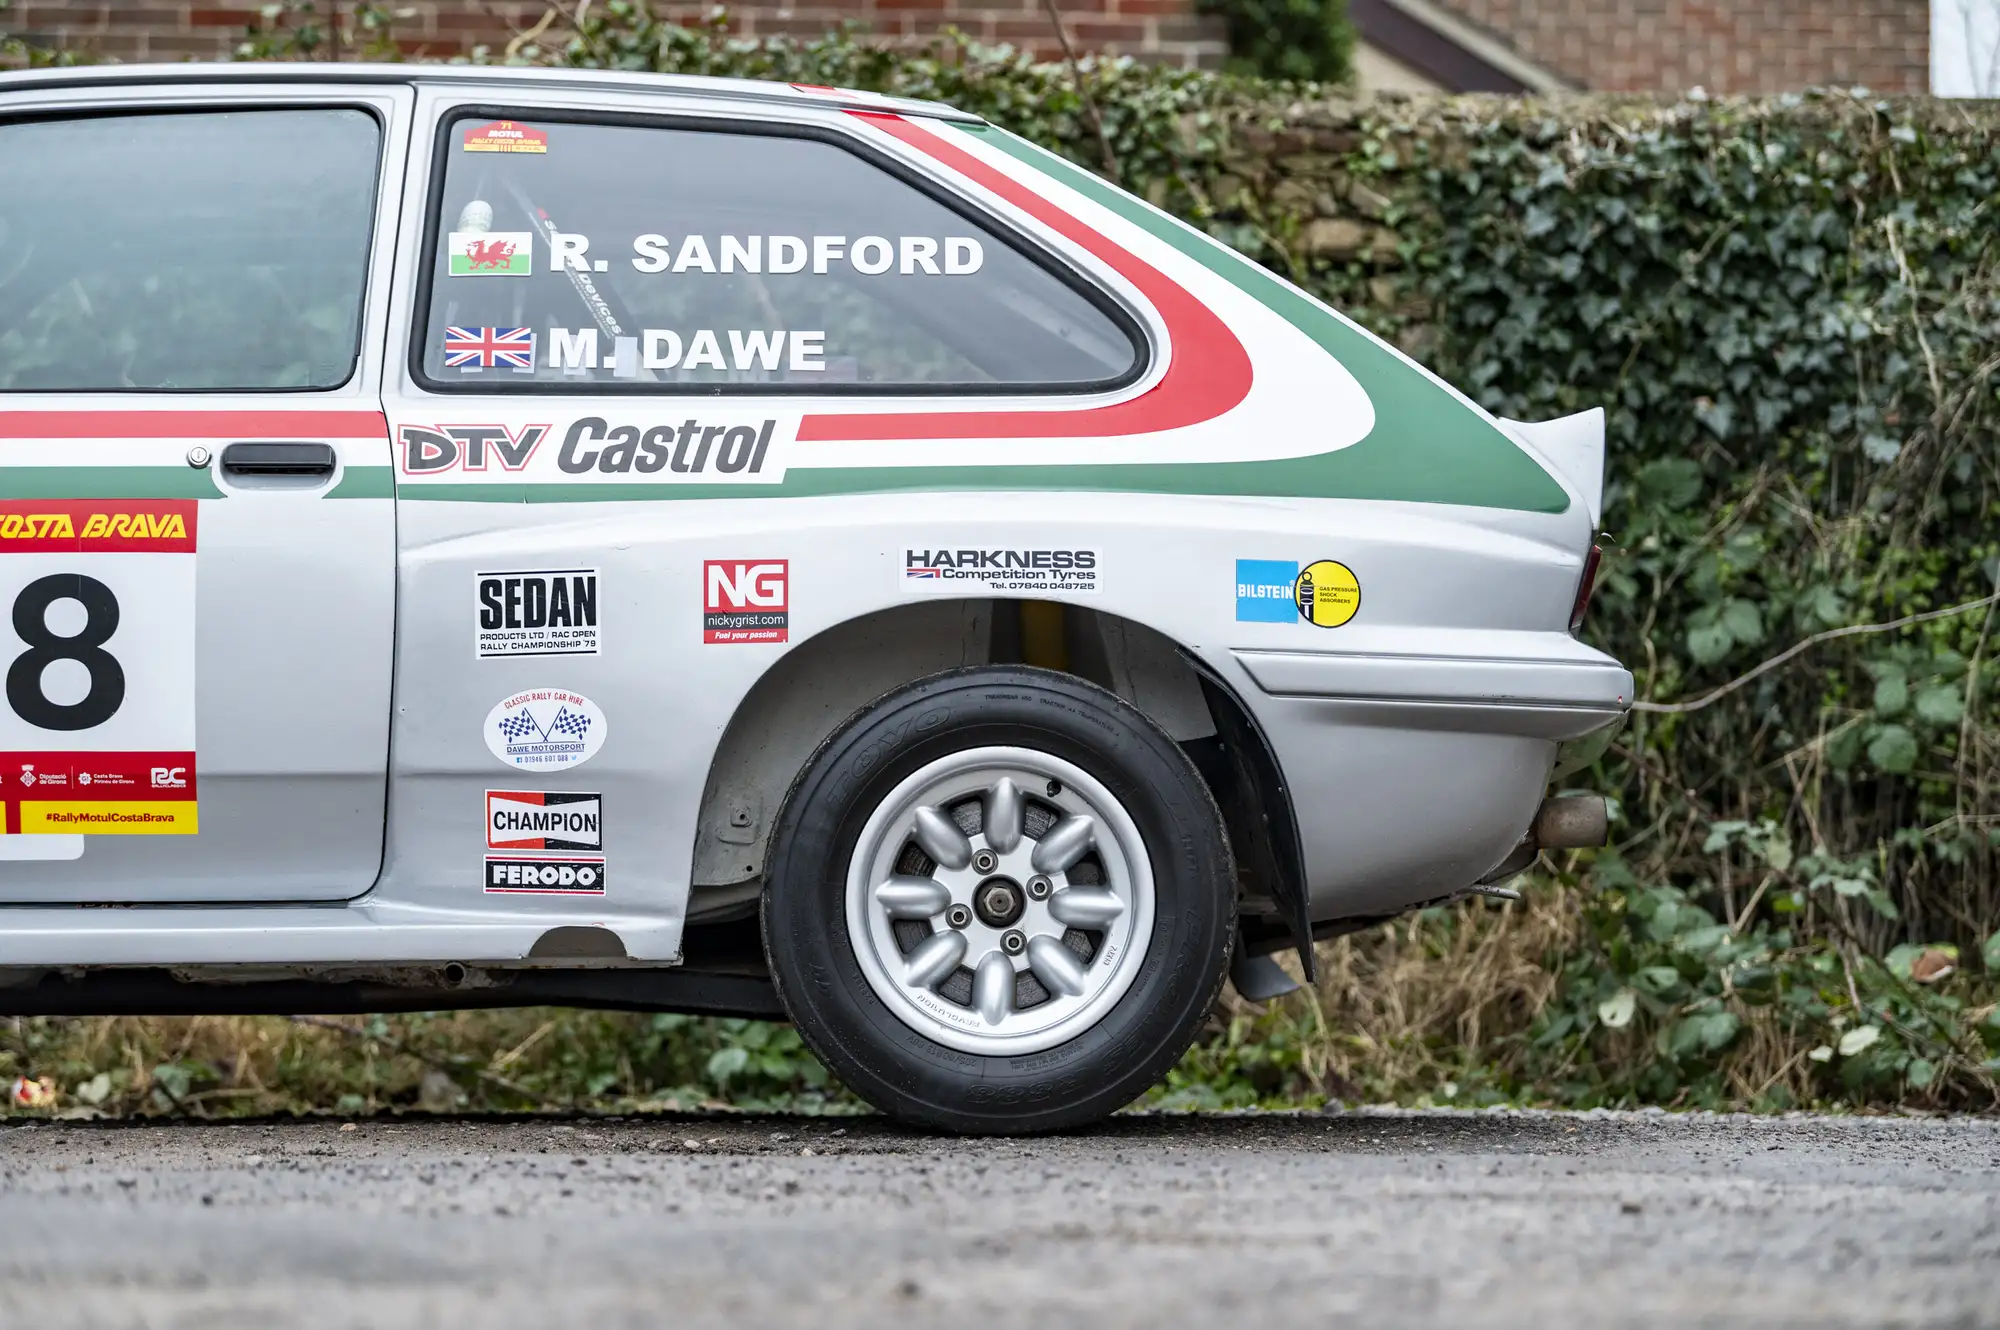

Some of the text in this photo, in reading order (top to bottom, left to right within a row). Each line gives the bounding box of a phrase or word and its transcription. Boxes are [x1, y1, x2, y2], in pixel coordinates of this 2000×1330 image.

[501, 122, 512, 130] 71
[550, 233, 608, 272] R.
[632, 234, 984, 275] SANDFORD
[578, 273, 622, 334] Devices
[549, 327, 827, 372] M. DAWE
[398, 424, 552, 475] DTV
[557, 417, 776, 474] Castrol
[80, 514, 187, 539] BRAVA
[906, 549, 1096, 569] HARKNESS
[942, 568, 1096, 582] Competition Tyres
[708, 564, 784, 607] NG
[990, 582, 1095, 590] Tel. 07840 048725
[1238, 584, 1294, 600] BILSTEIN
[480, 576, 597, 630] SEDAN
[708, 615, 784, 628] nickygrist.com
[511, 640, 580, 650] CHAMPIONSHIP
[749, 631, 778, 640] passion
[12, 573, 120, 731] 8
[504, 695, 530, 709] CLASSIC
[532, 692, 551, 700] RALLY
[568, 695, 584, 706] HIRE
[531, 744, 585, 752] MOTORSPORT
[826, 706, 951, 807] TOYO
[39, 773, 67, 781] Diputació
[46, 813, 175, 823] #RallyMotulCostaBrava
[493, 811, 597, 832] CHAMPION
[493, 865, 596, 885] FERODO
[917, 992, 981, 1029] REVOLUTION
